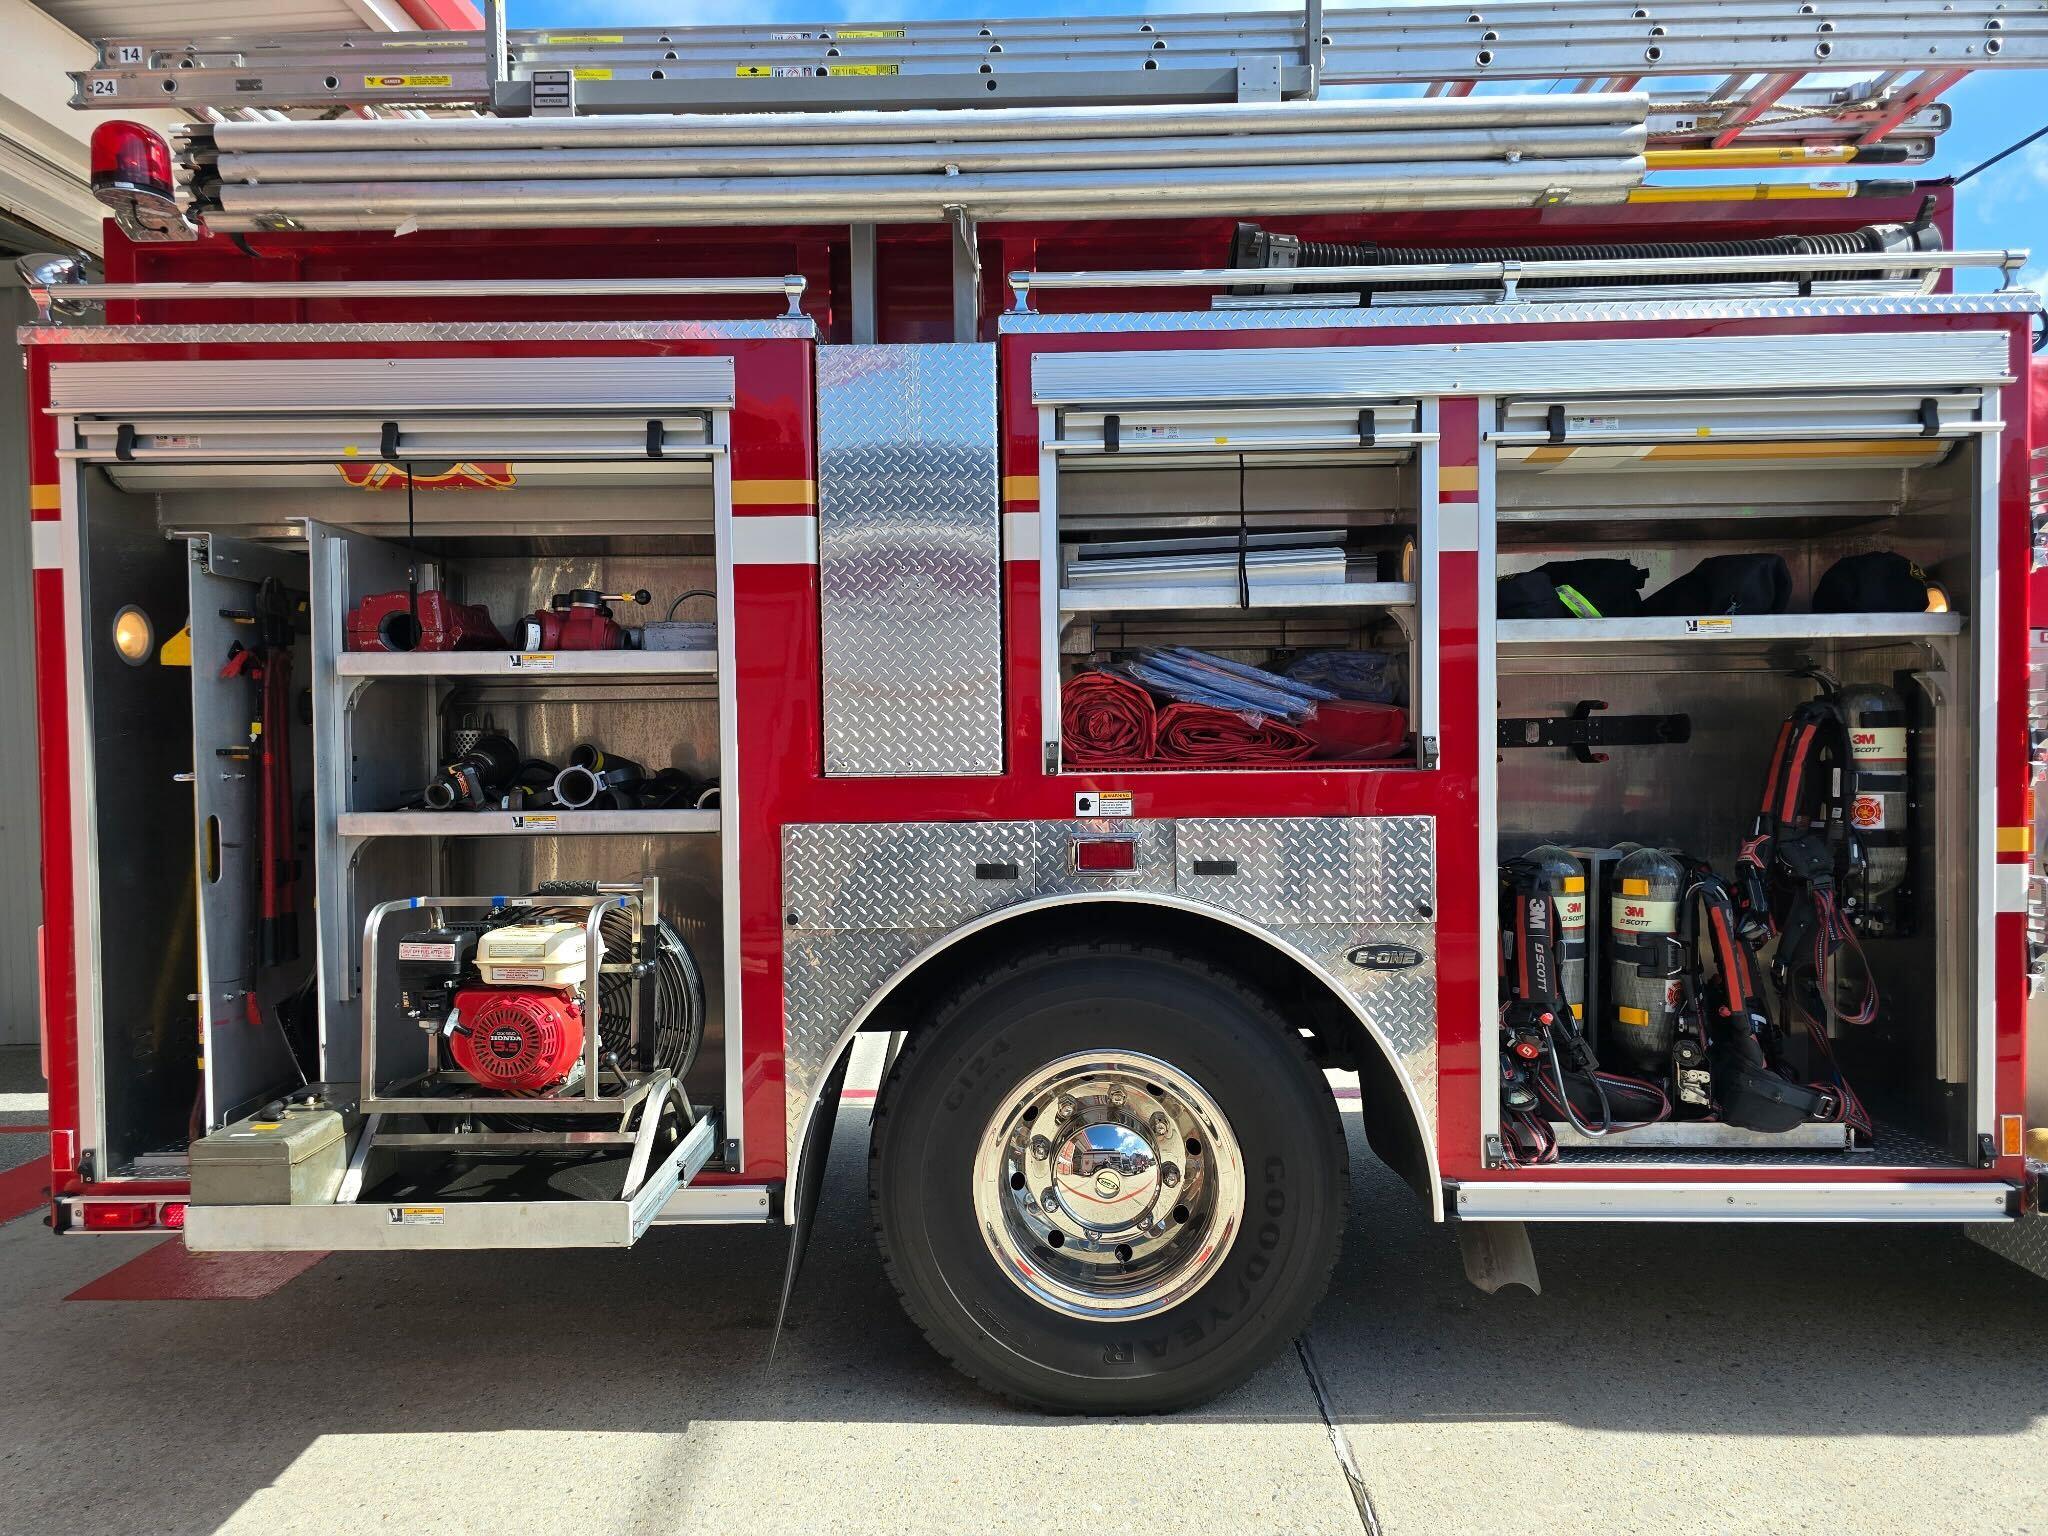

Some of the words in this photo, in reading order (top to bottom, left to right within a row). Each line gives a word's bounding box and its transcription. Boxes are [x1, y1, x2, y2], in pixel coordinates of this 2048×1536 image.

[122, 48, 140, 61] 14
[95, 81, 115, 94] 24
[1853, 734, 1875, 745] 3M
[1529, 898, 1546, 929] 3M
[1567, 903, 1582, 913] 3M
[1625, 906, 1645, 918] 3M
[1568, 914, 1584, 922] SCOTT
[1355, 951, 1417, 964] E-ONE
[1534, 957, 1547, 992] SCOTT
[493, 1041, 518, 1052] 5.5
[1102, 1155, 1286, 1366] GOODYEAR
